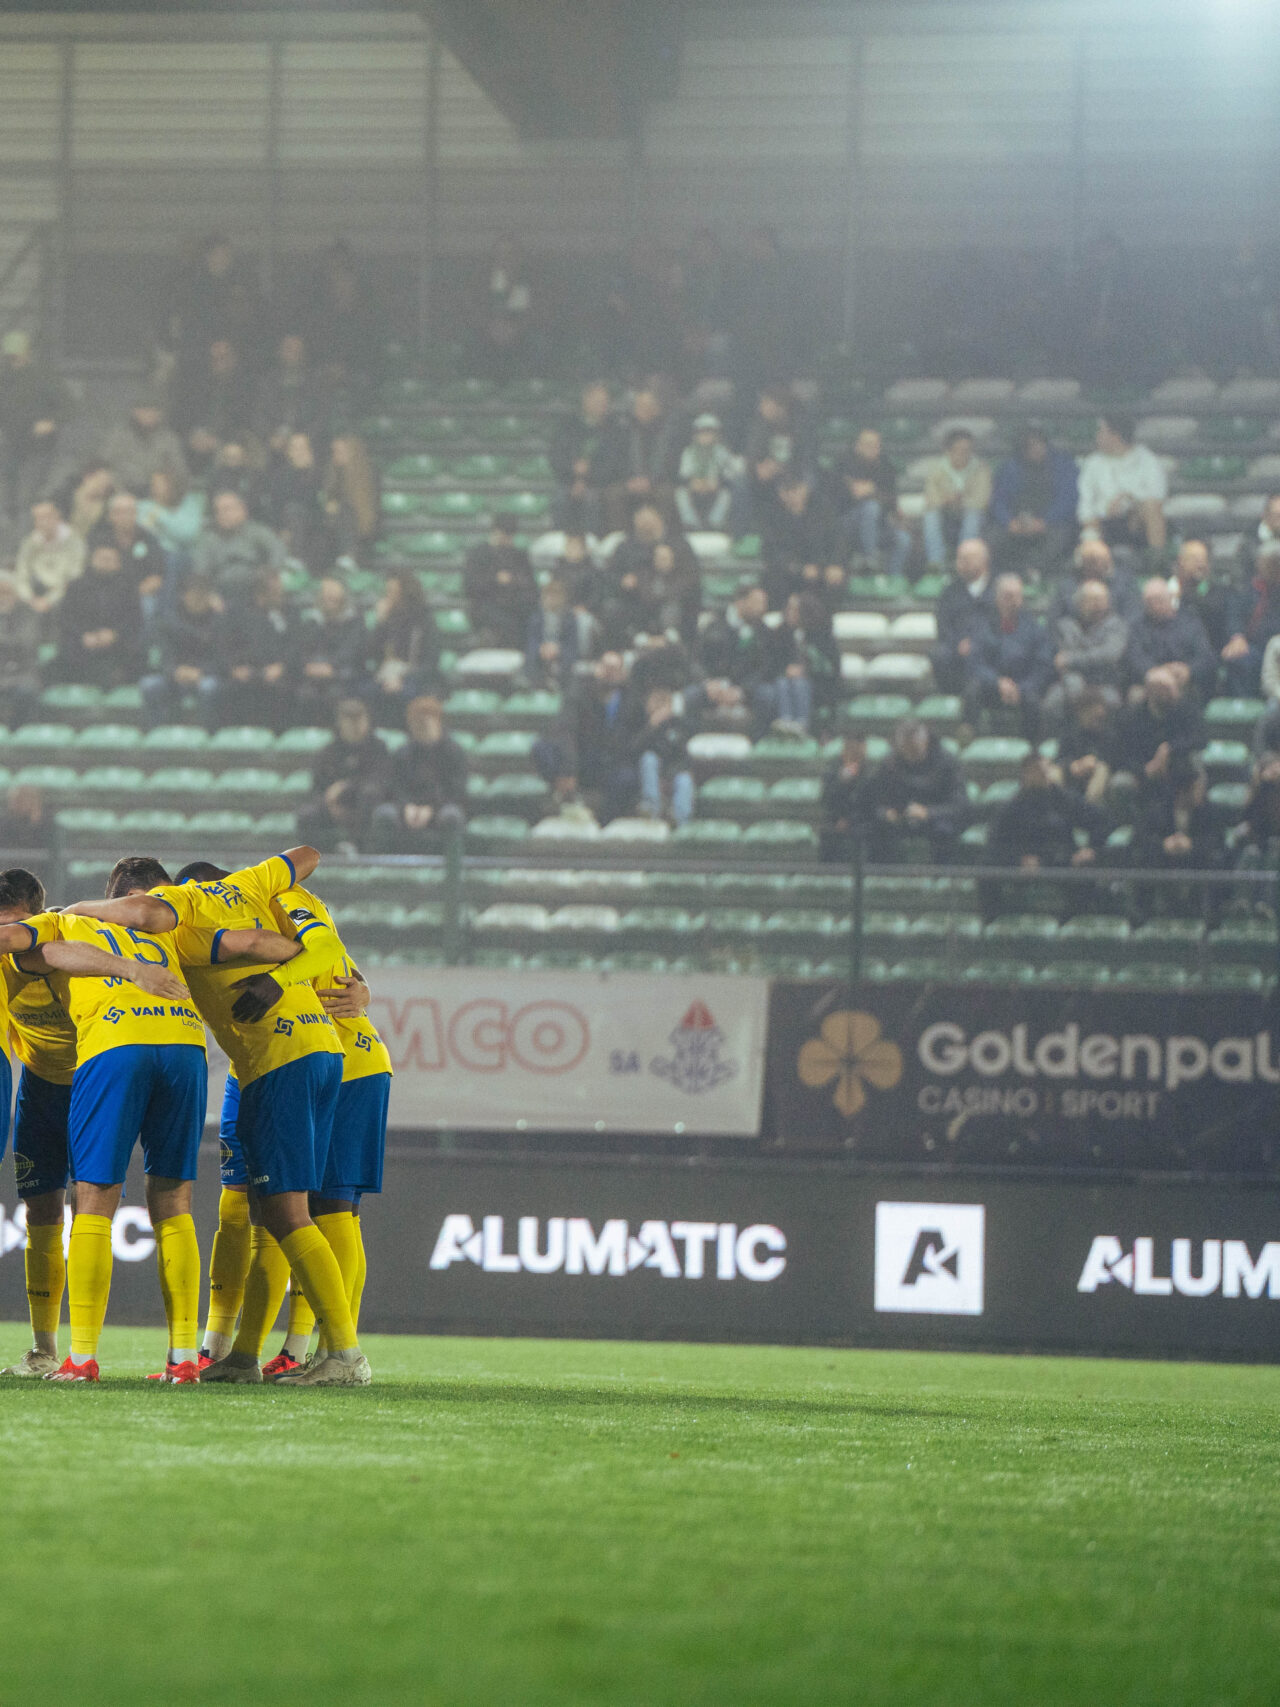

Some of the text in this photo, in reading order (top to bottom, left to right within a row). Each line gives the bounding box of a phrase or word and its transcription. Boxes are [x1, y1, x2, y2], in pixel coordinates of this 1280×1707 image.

[96, 928, 169, 968] 15
[130, 1005, 166, 1017] VAN
[295, 1013, 320, 1025] VAN
[918, 1085, 1160, 1121] CASINO SPORT
[429, 1214, 787, 1281] ALUMATIC
